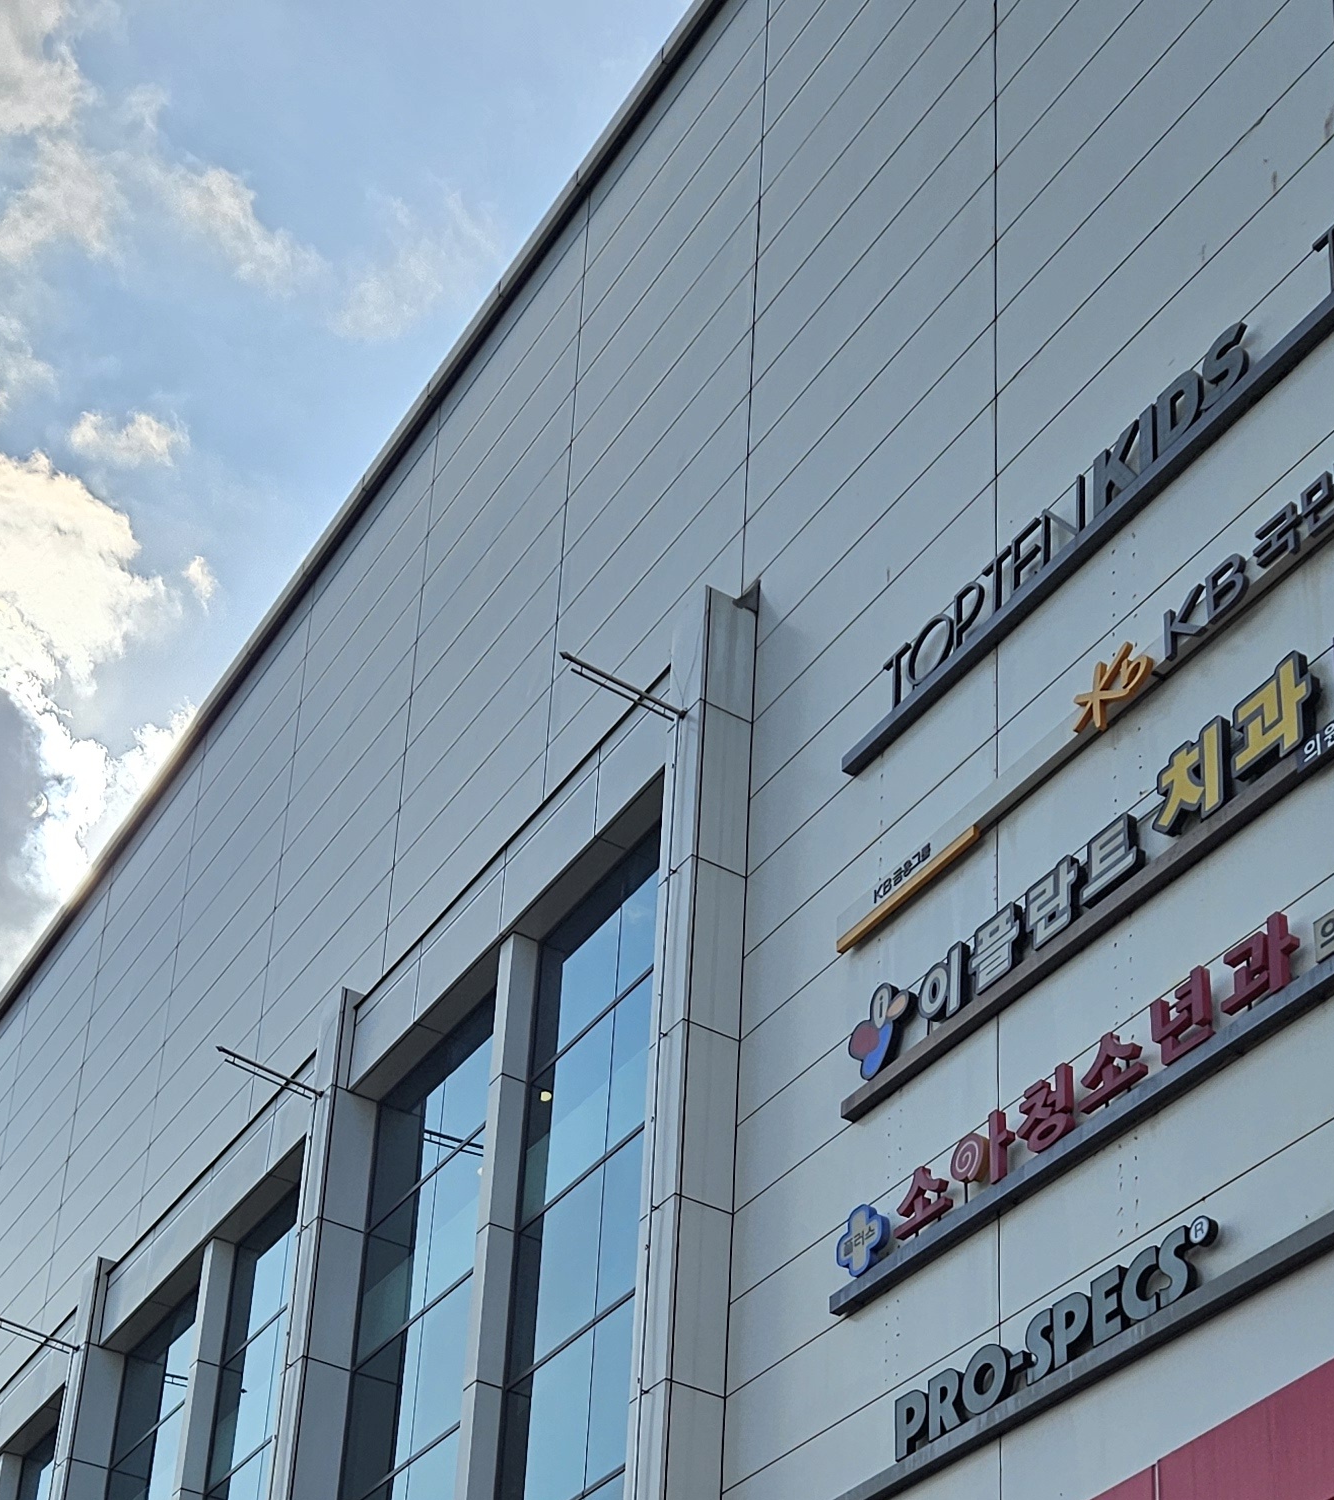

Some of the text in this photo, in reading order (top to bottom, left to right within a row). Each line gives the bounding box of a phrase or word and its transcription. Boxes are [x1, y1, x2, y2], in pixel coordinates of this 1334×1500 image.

[1093, 322, 1249, 519] KIDS
[918, 813, 1146, 1021] 이플란트
[1152, 649, 1320, 836] 치과
[895, 912, 1300, 1241] 소아청소년과
